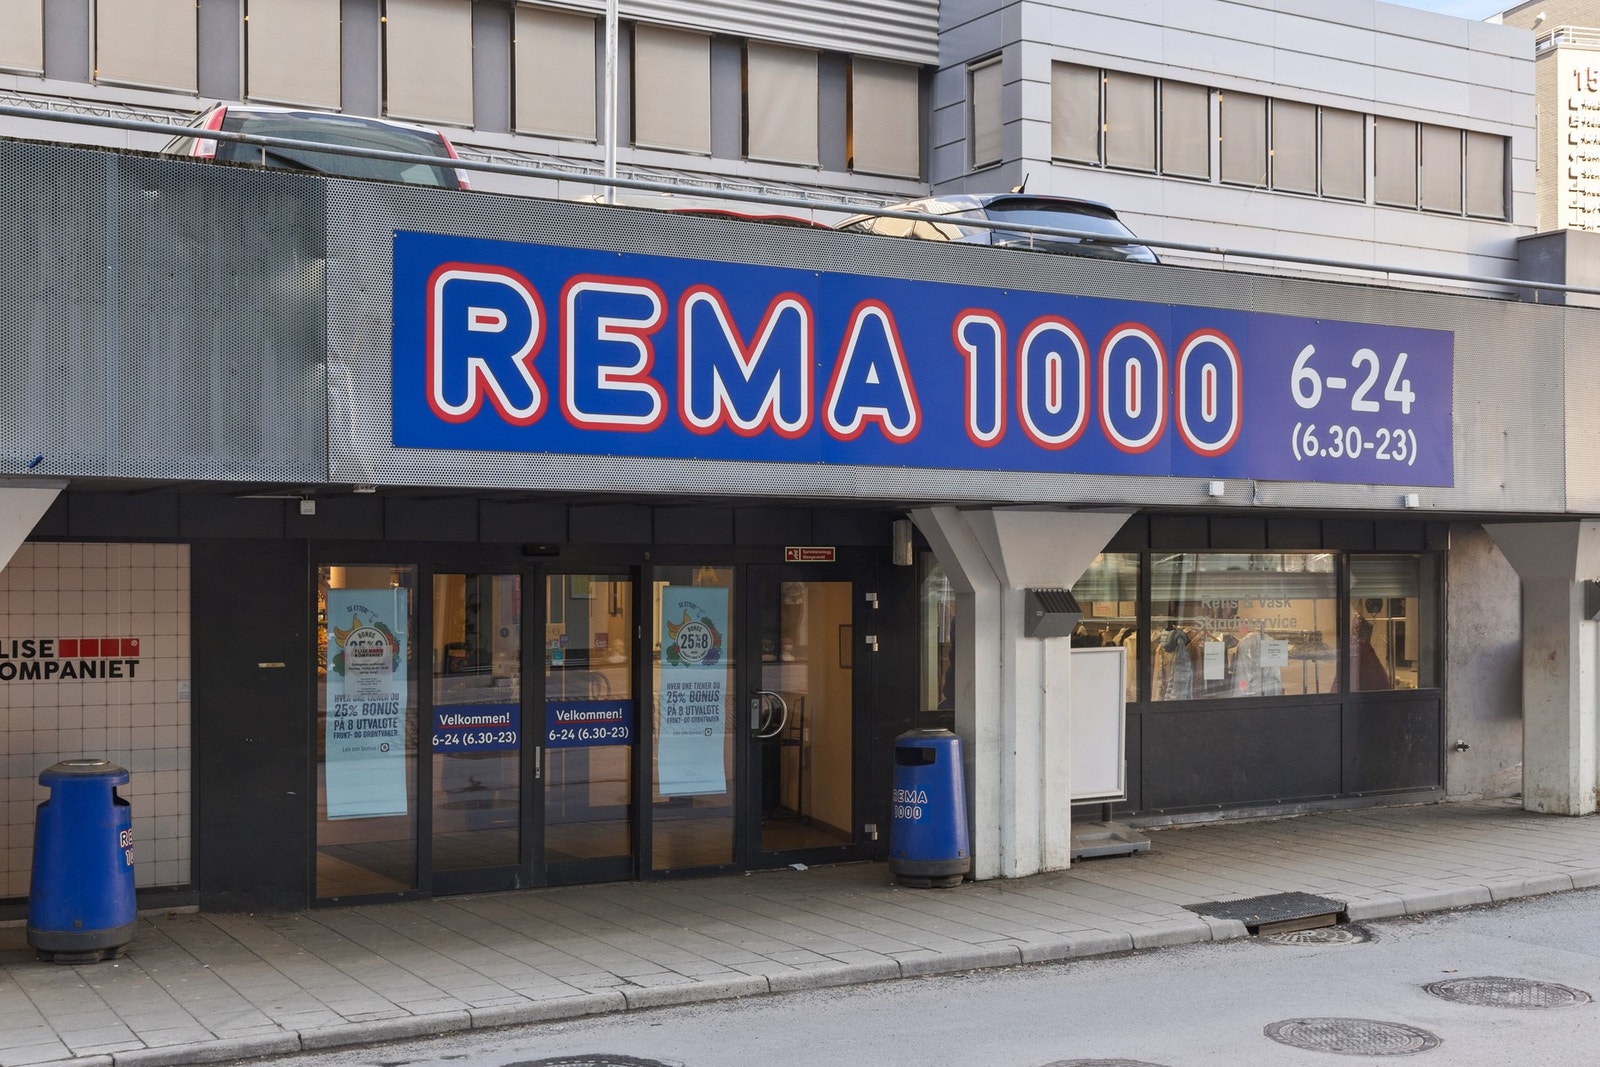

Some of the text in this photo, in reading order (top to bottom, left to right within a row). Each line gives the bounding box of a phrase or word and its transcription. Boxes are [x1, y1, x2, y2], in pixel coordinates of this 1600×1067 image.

[426, 261, 1243, 457] REMA 1000
[1291, 344, 1415, 414] 6-24
[1292, 422, 1417, 466] (6.30-23)
[1201, 594, 1239, 609] Rens
[1258, 593, 1292, 608] Vask
[680, 634, 694, 649] 25
[701, 634, 708, 649] 8
[0, 660, 139, 681] OMPANIET
[667, 690, 720, 703] 25% BONUS
[334, 702, 399, 717] 25% BONUS
[556, 708, 623, 721] Velkommen!
[667, 703, 677, 716] PÅ
[685, 704, 720, 715] UTVALGTE
[334, 717, 398, 731] PÅ 8 UTVALGTE
[439, 712, 510, 726] Velkommen!
[432, 731, 517, 746] 6-24 (6.30-23)
[548, 726, 630, 741] 6-24 (6.30-23)
